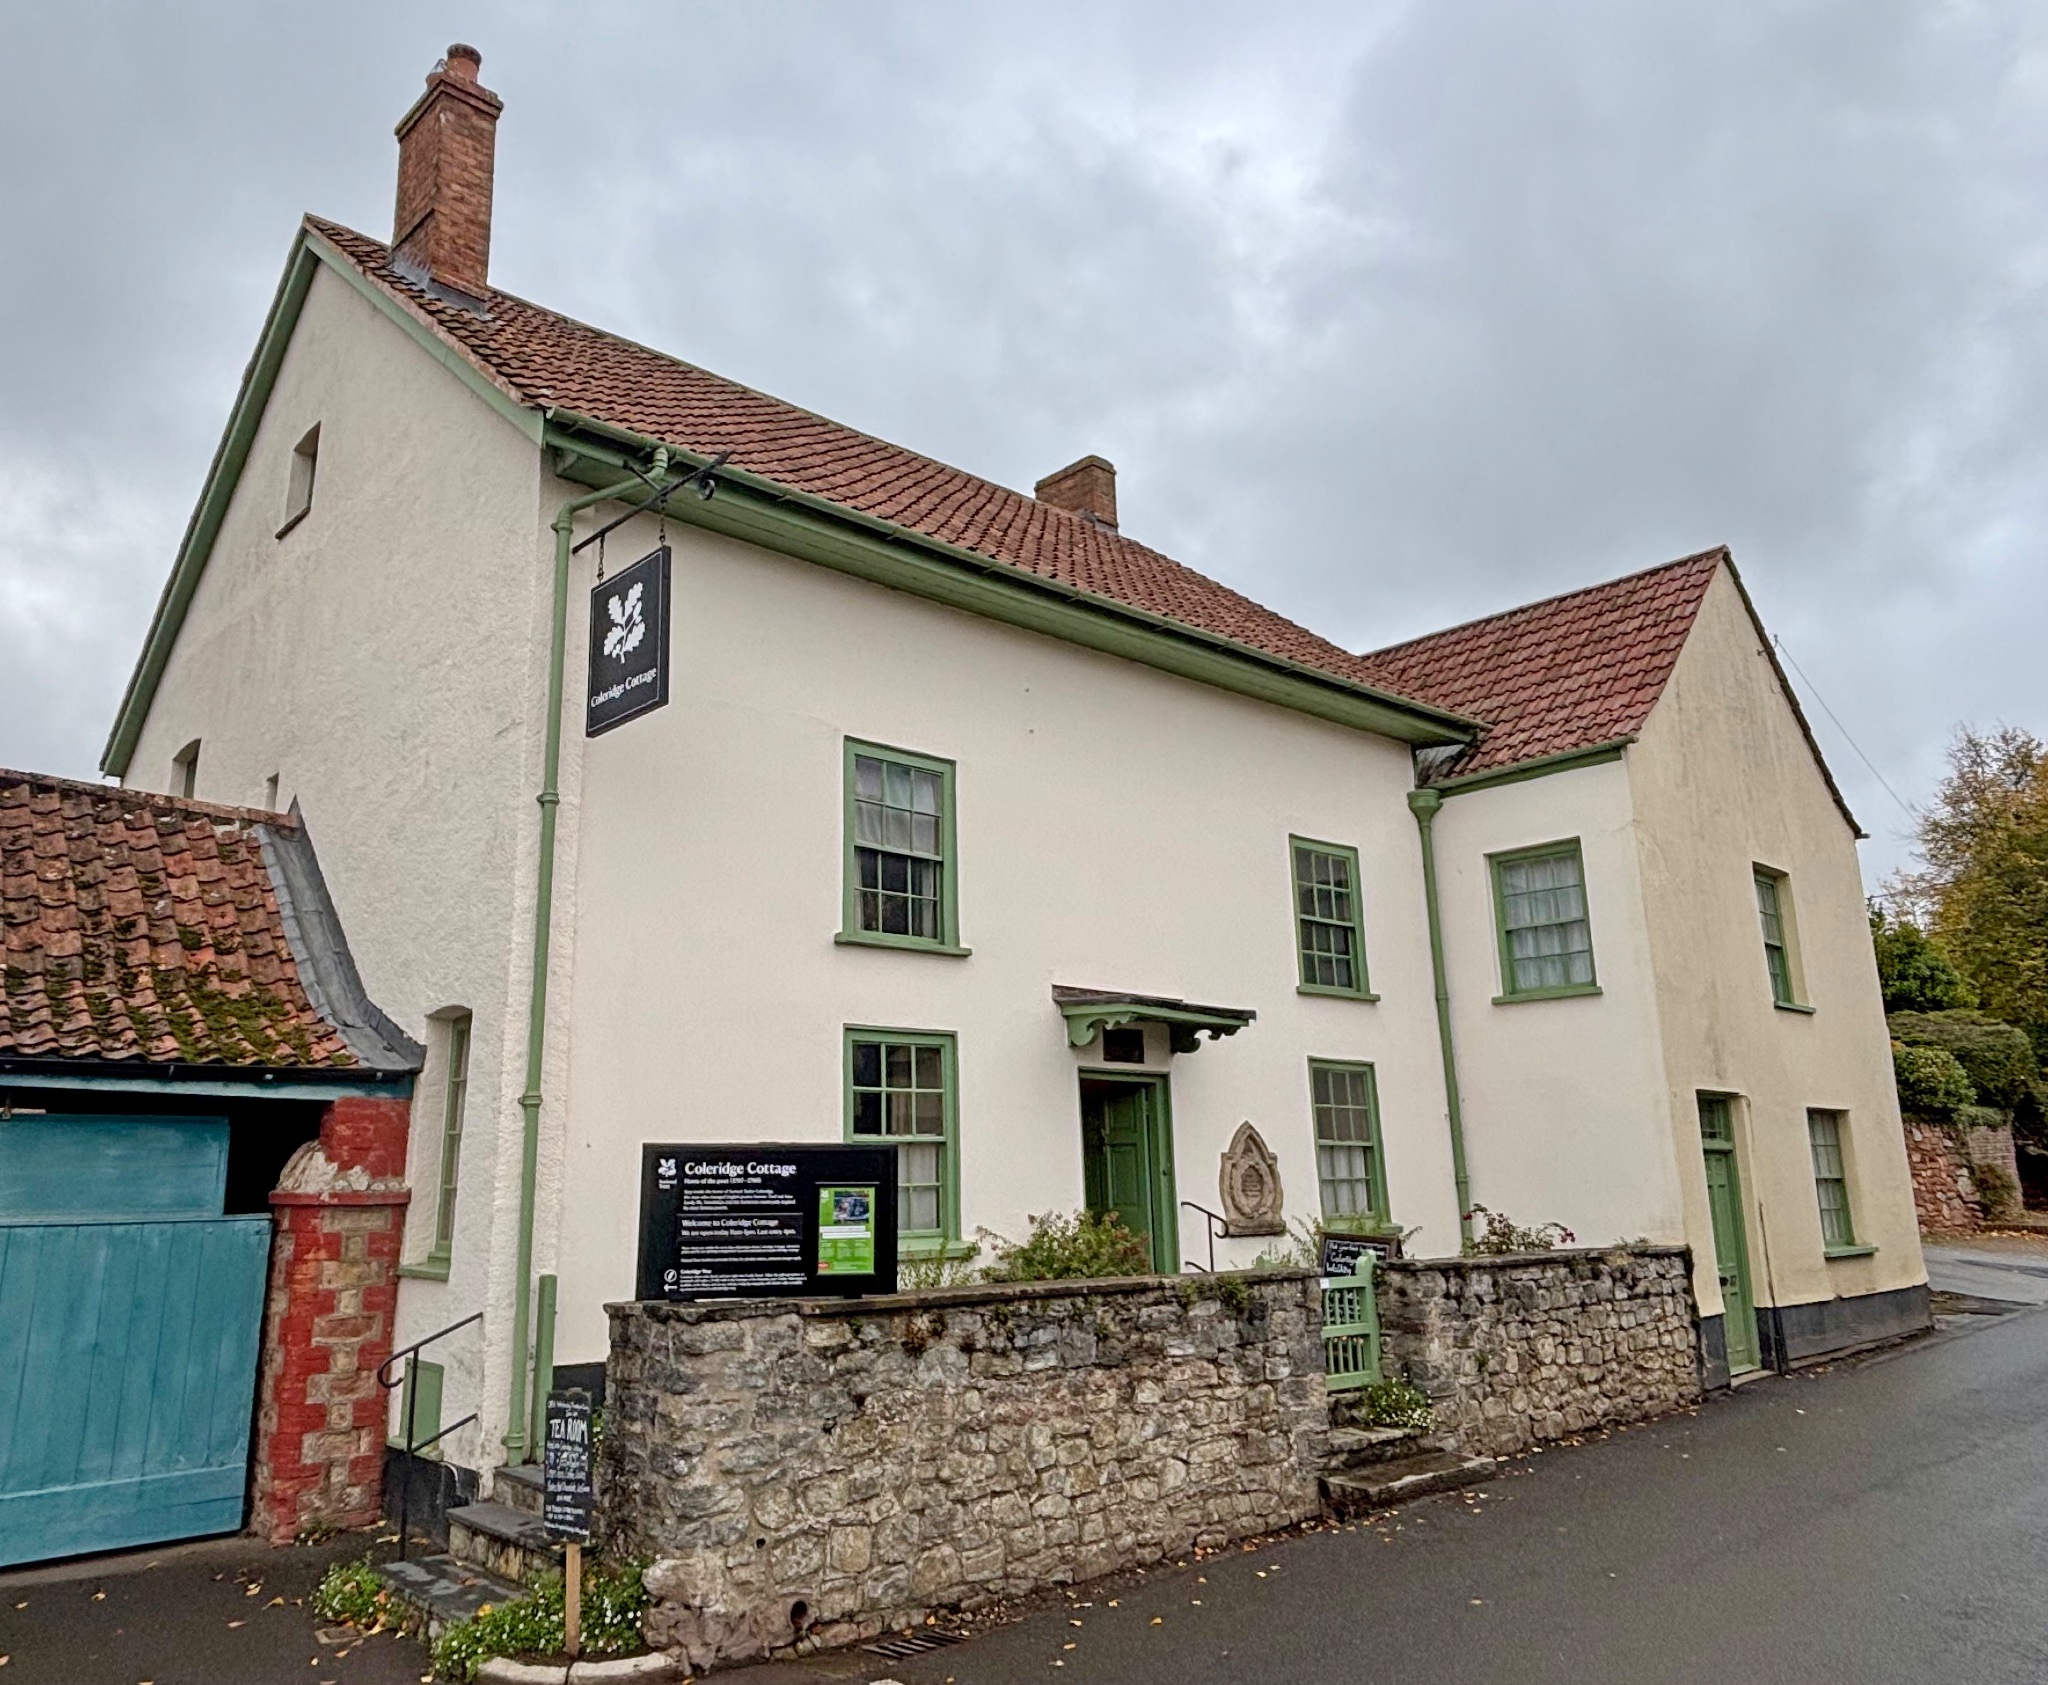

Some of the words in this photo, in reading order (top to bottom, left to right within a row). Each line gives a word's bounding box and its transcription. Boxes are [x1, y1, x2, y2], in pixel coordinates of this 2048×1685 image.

[591, 684, 625, 707] Coleridge
[625, 667, 657, 690] Cottage
[684, 1161, 744, 1177] Coleridge
[747, 1161, 797, 1177] Cottage
[681, 1219, 712, 1227] Welcome
[712, 1219, 720, 1227] to
[720, 1218, 752, 1227] Coleridge
[752, 1218, 779, 1227] Cottage
[549, 1418, 566, 1439] TEA
[566, 1417, 588, 1444] ROOM
